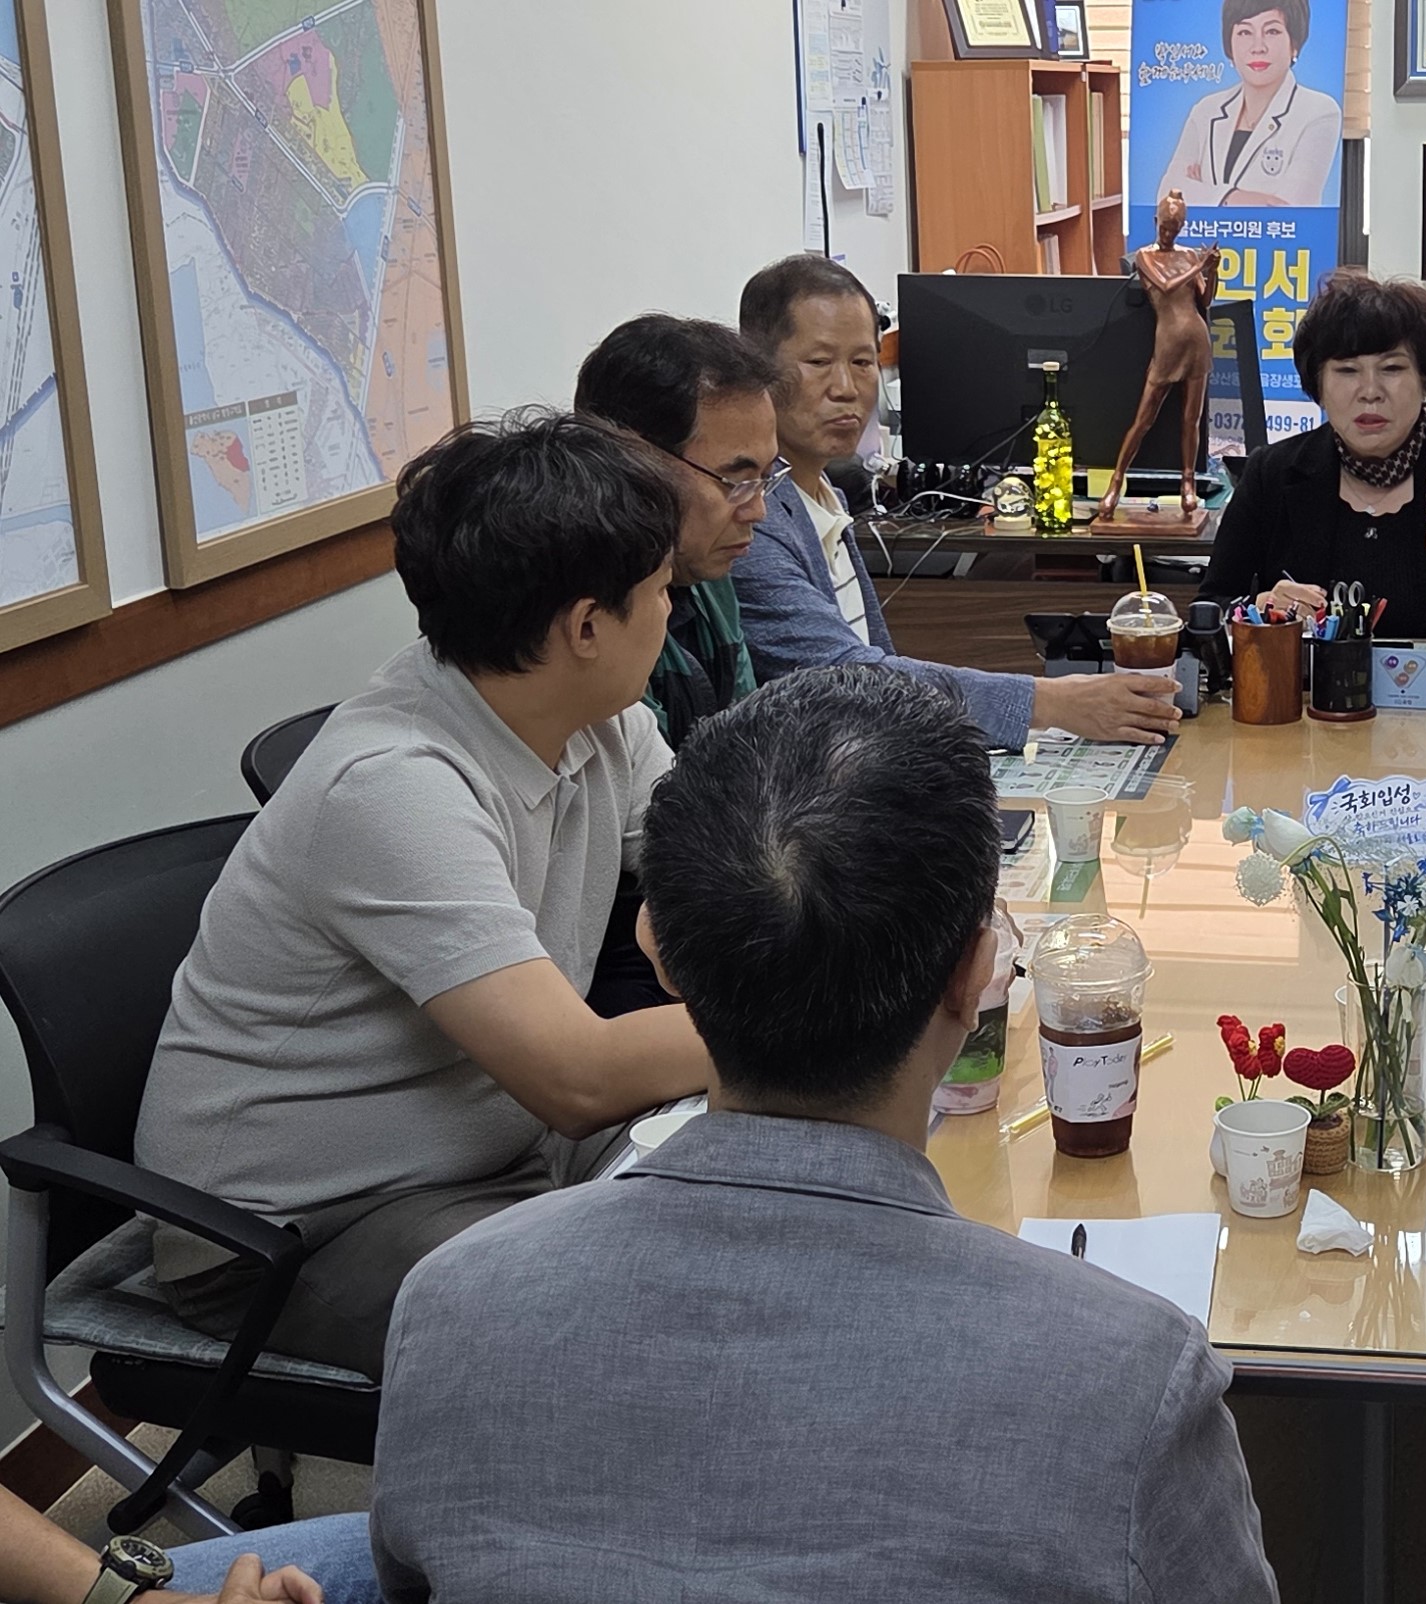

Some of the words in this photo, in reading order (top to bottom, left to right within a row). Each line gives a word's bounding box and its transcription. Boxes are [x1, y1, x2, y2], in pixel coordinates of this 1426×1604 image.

[1266, 221, 1296, 238] 후보
[1214, 248, 1310, 302] 인서
[1050, 298, 1072, 313] LG
[1340, 783, 1411, 814] 국회입성
[1354, 813, 1422, 838] 축하드립니다
